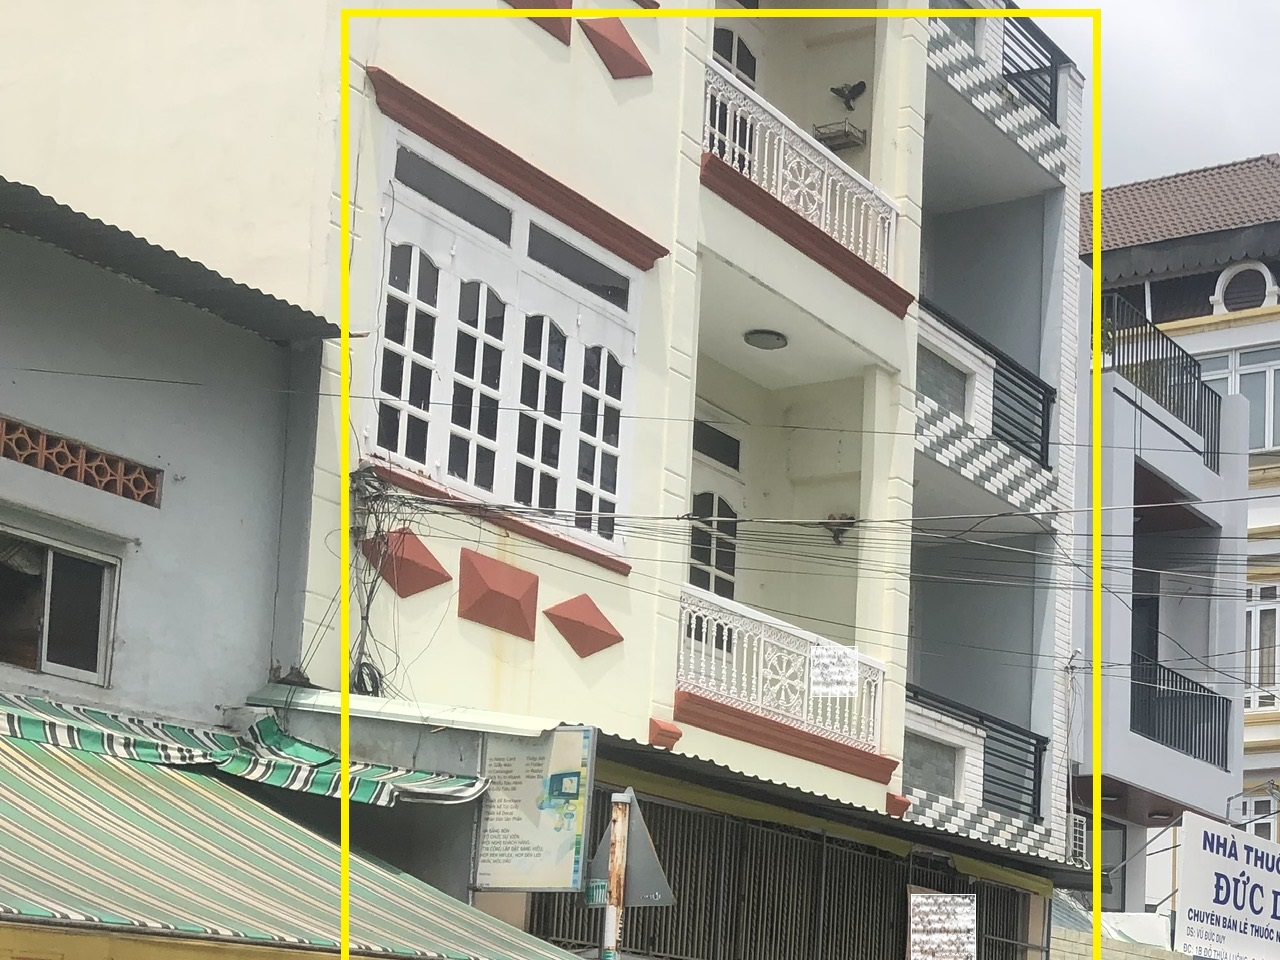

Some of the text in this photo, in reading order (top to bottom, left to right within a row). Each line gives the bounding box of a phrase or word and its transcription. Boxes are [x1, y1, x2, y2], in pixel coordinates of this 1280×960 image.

[1202, 830, 1238, 861] NHÀ
[1213, 870, 1264, 915] ĐỨC
[1188, 908, 1220, 927] CHUYÊN
[1222, 916, 1238, 932] BÁN
[1240, 918, 1248, 935] LẺ
[1250, 922, 1274, 941] THUỐC
[1216, 934, 1226, 944] DUY
